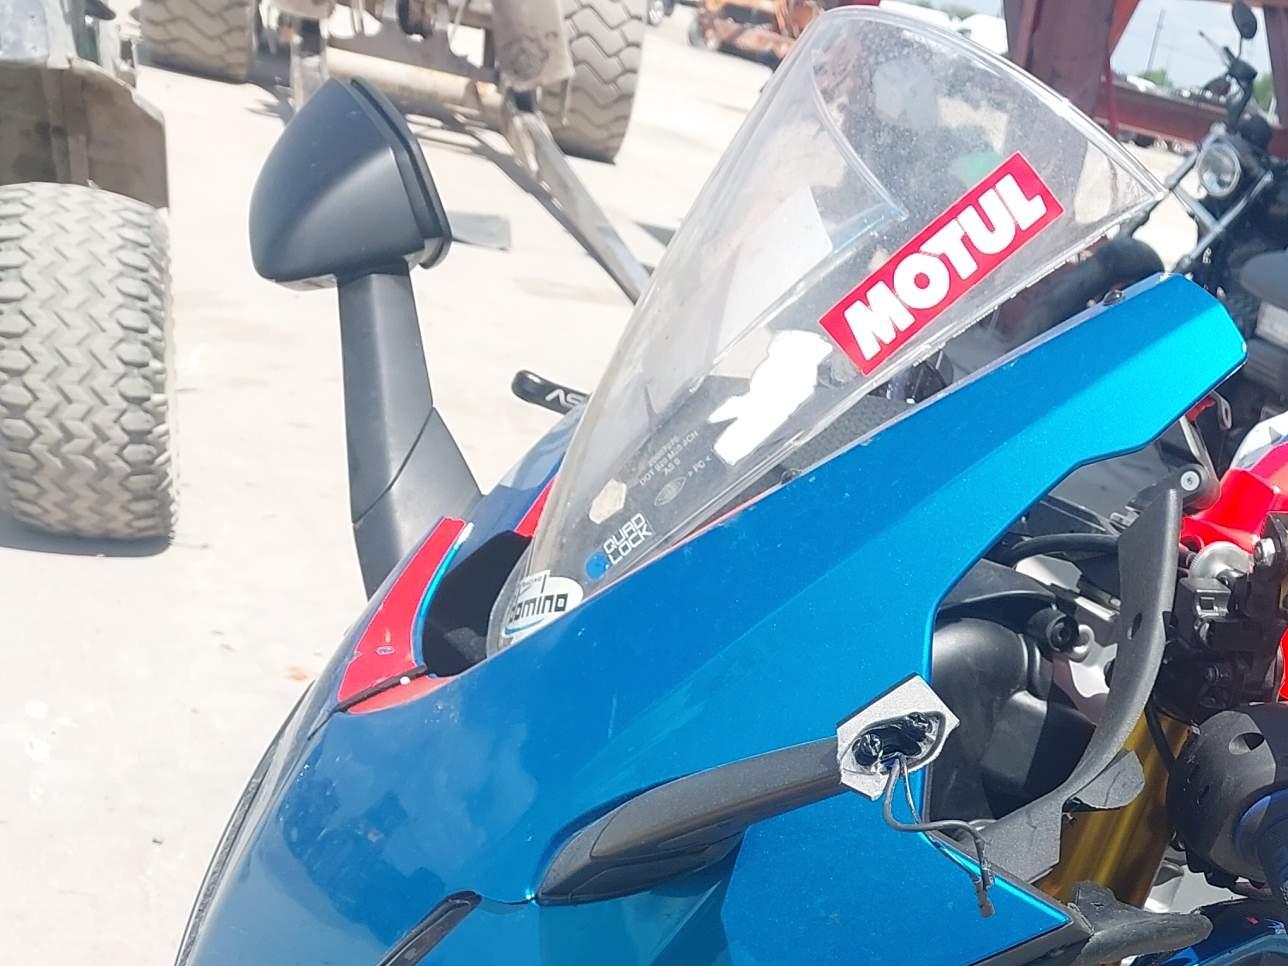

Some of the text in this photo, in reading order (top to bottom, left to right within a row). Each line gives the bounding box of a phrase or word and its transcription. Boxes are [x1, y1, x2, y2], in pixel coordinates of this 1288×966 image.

[844, 173, 1047, 361] MOTUL
[603, 513, 646, 554] QUAD
[607, 524, 652, 565] LOCK
